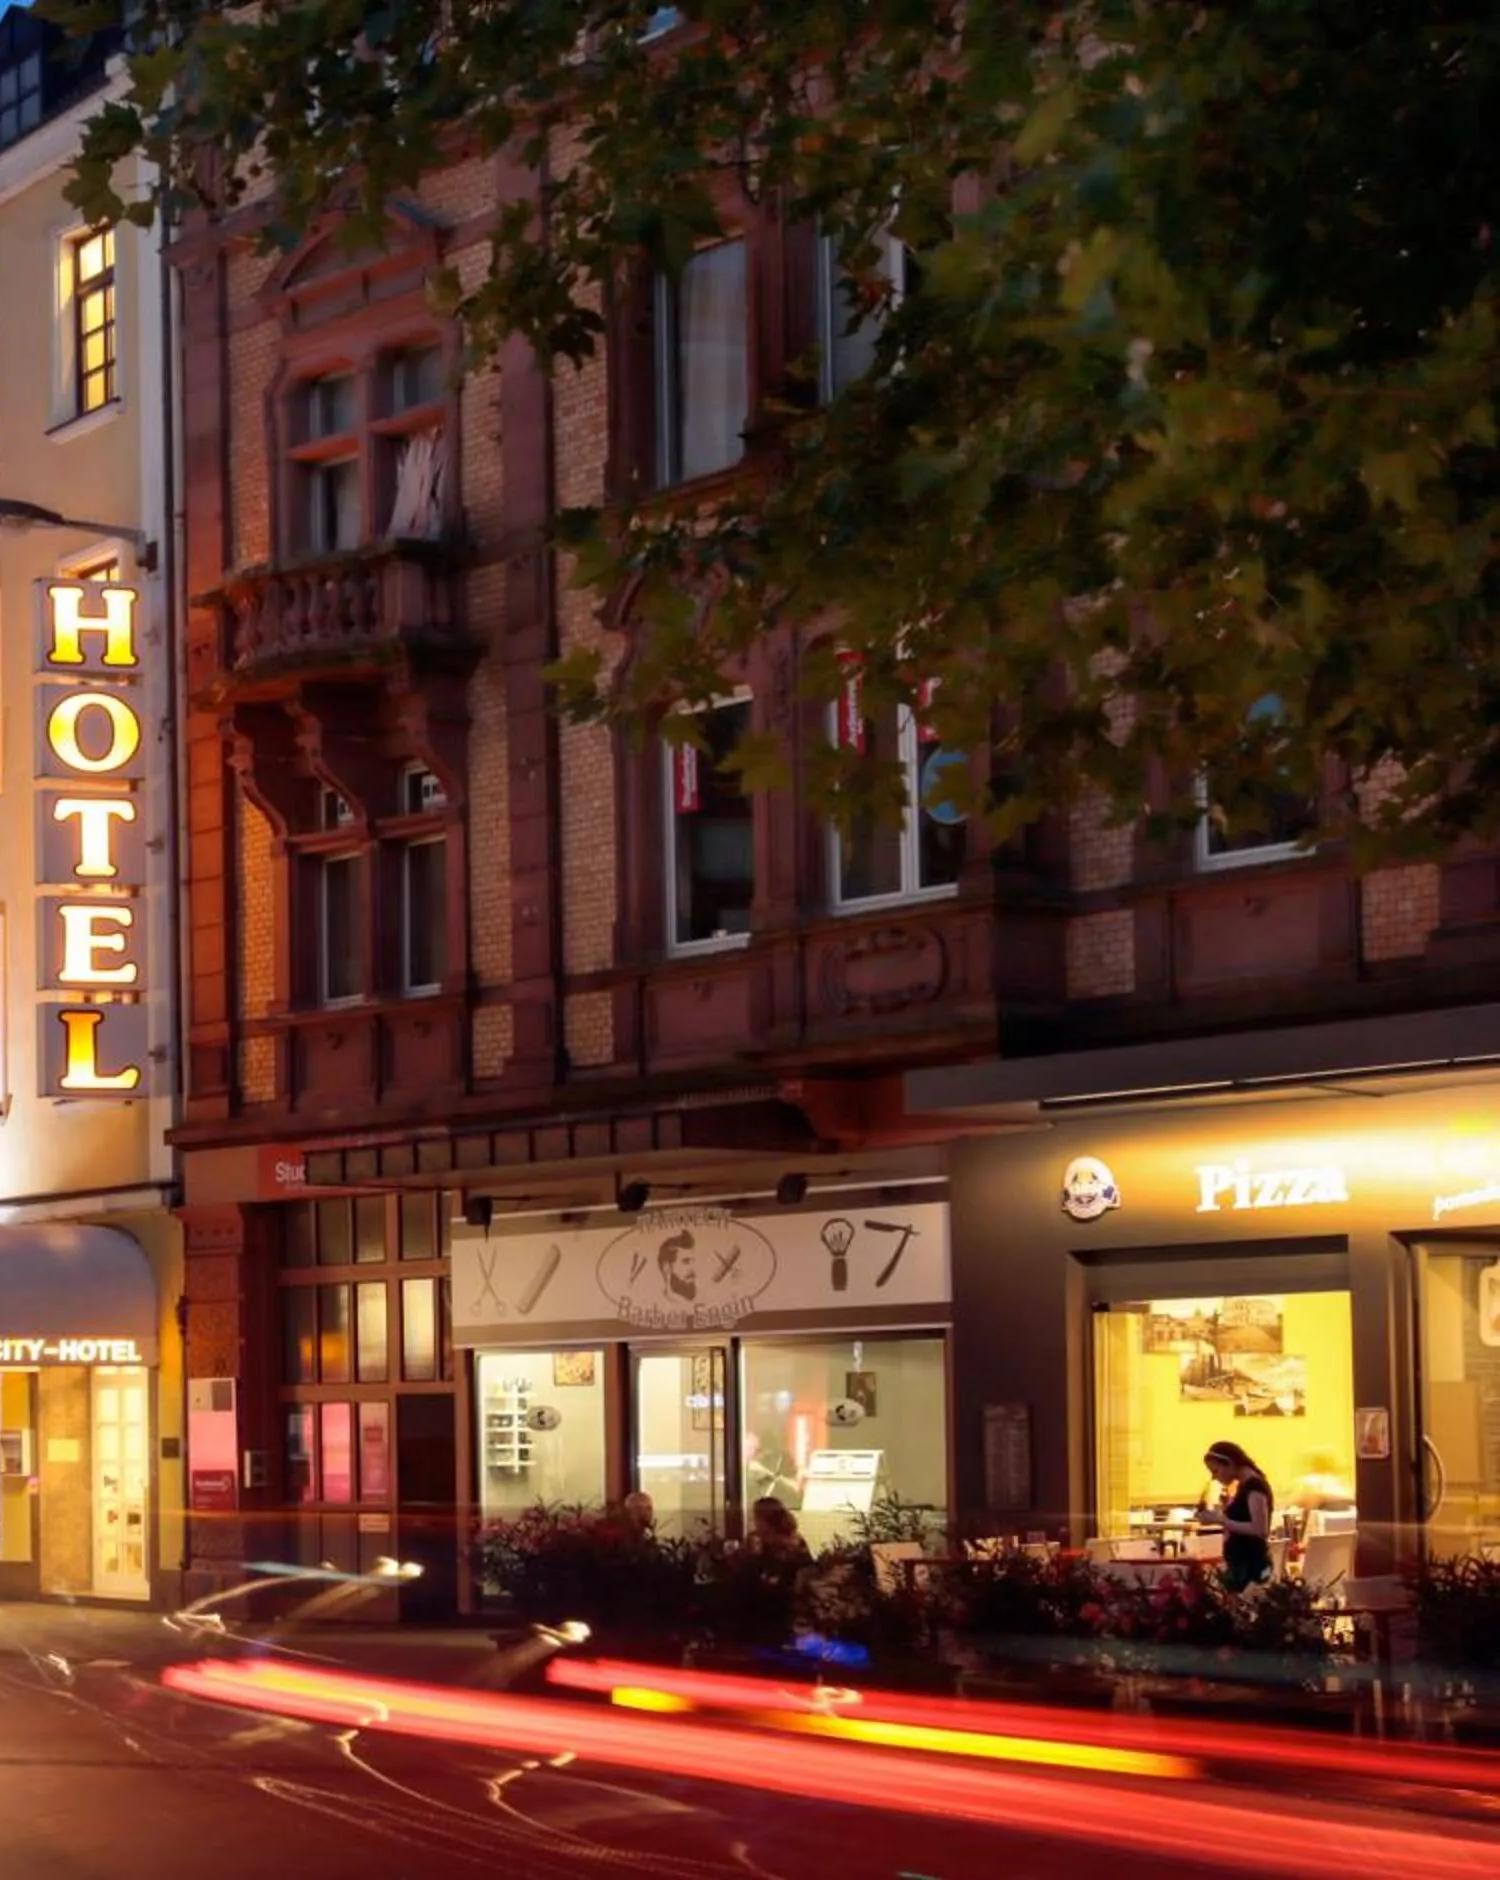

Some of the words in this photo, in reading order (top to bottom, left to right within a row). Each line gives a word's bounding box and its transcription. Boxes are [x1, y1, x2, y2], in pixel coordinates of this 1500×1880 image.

[47, 585, 141, 1092] HOTEL
[1194, 1157, 1350, 1213] Pizza
[616, 1295, 688, 1329] Barber
[693, 1295, 755, 1329] Engin
